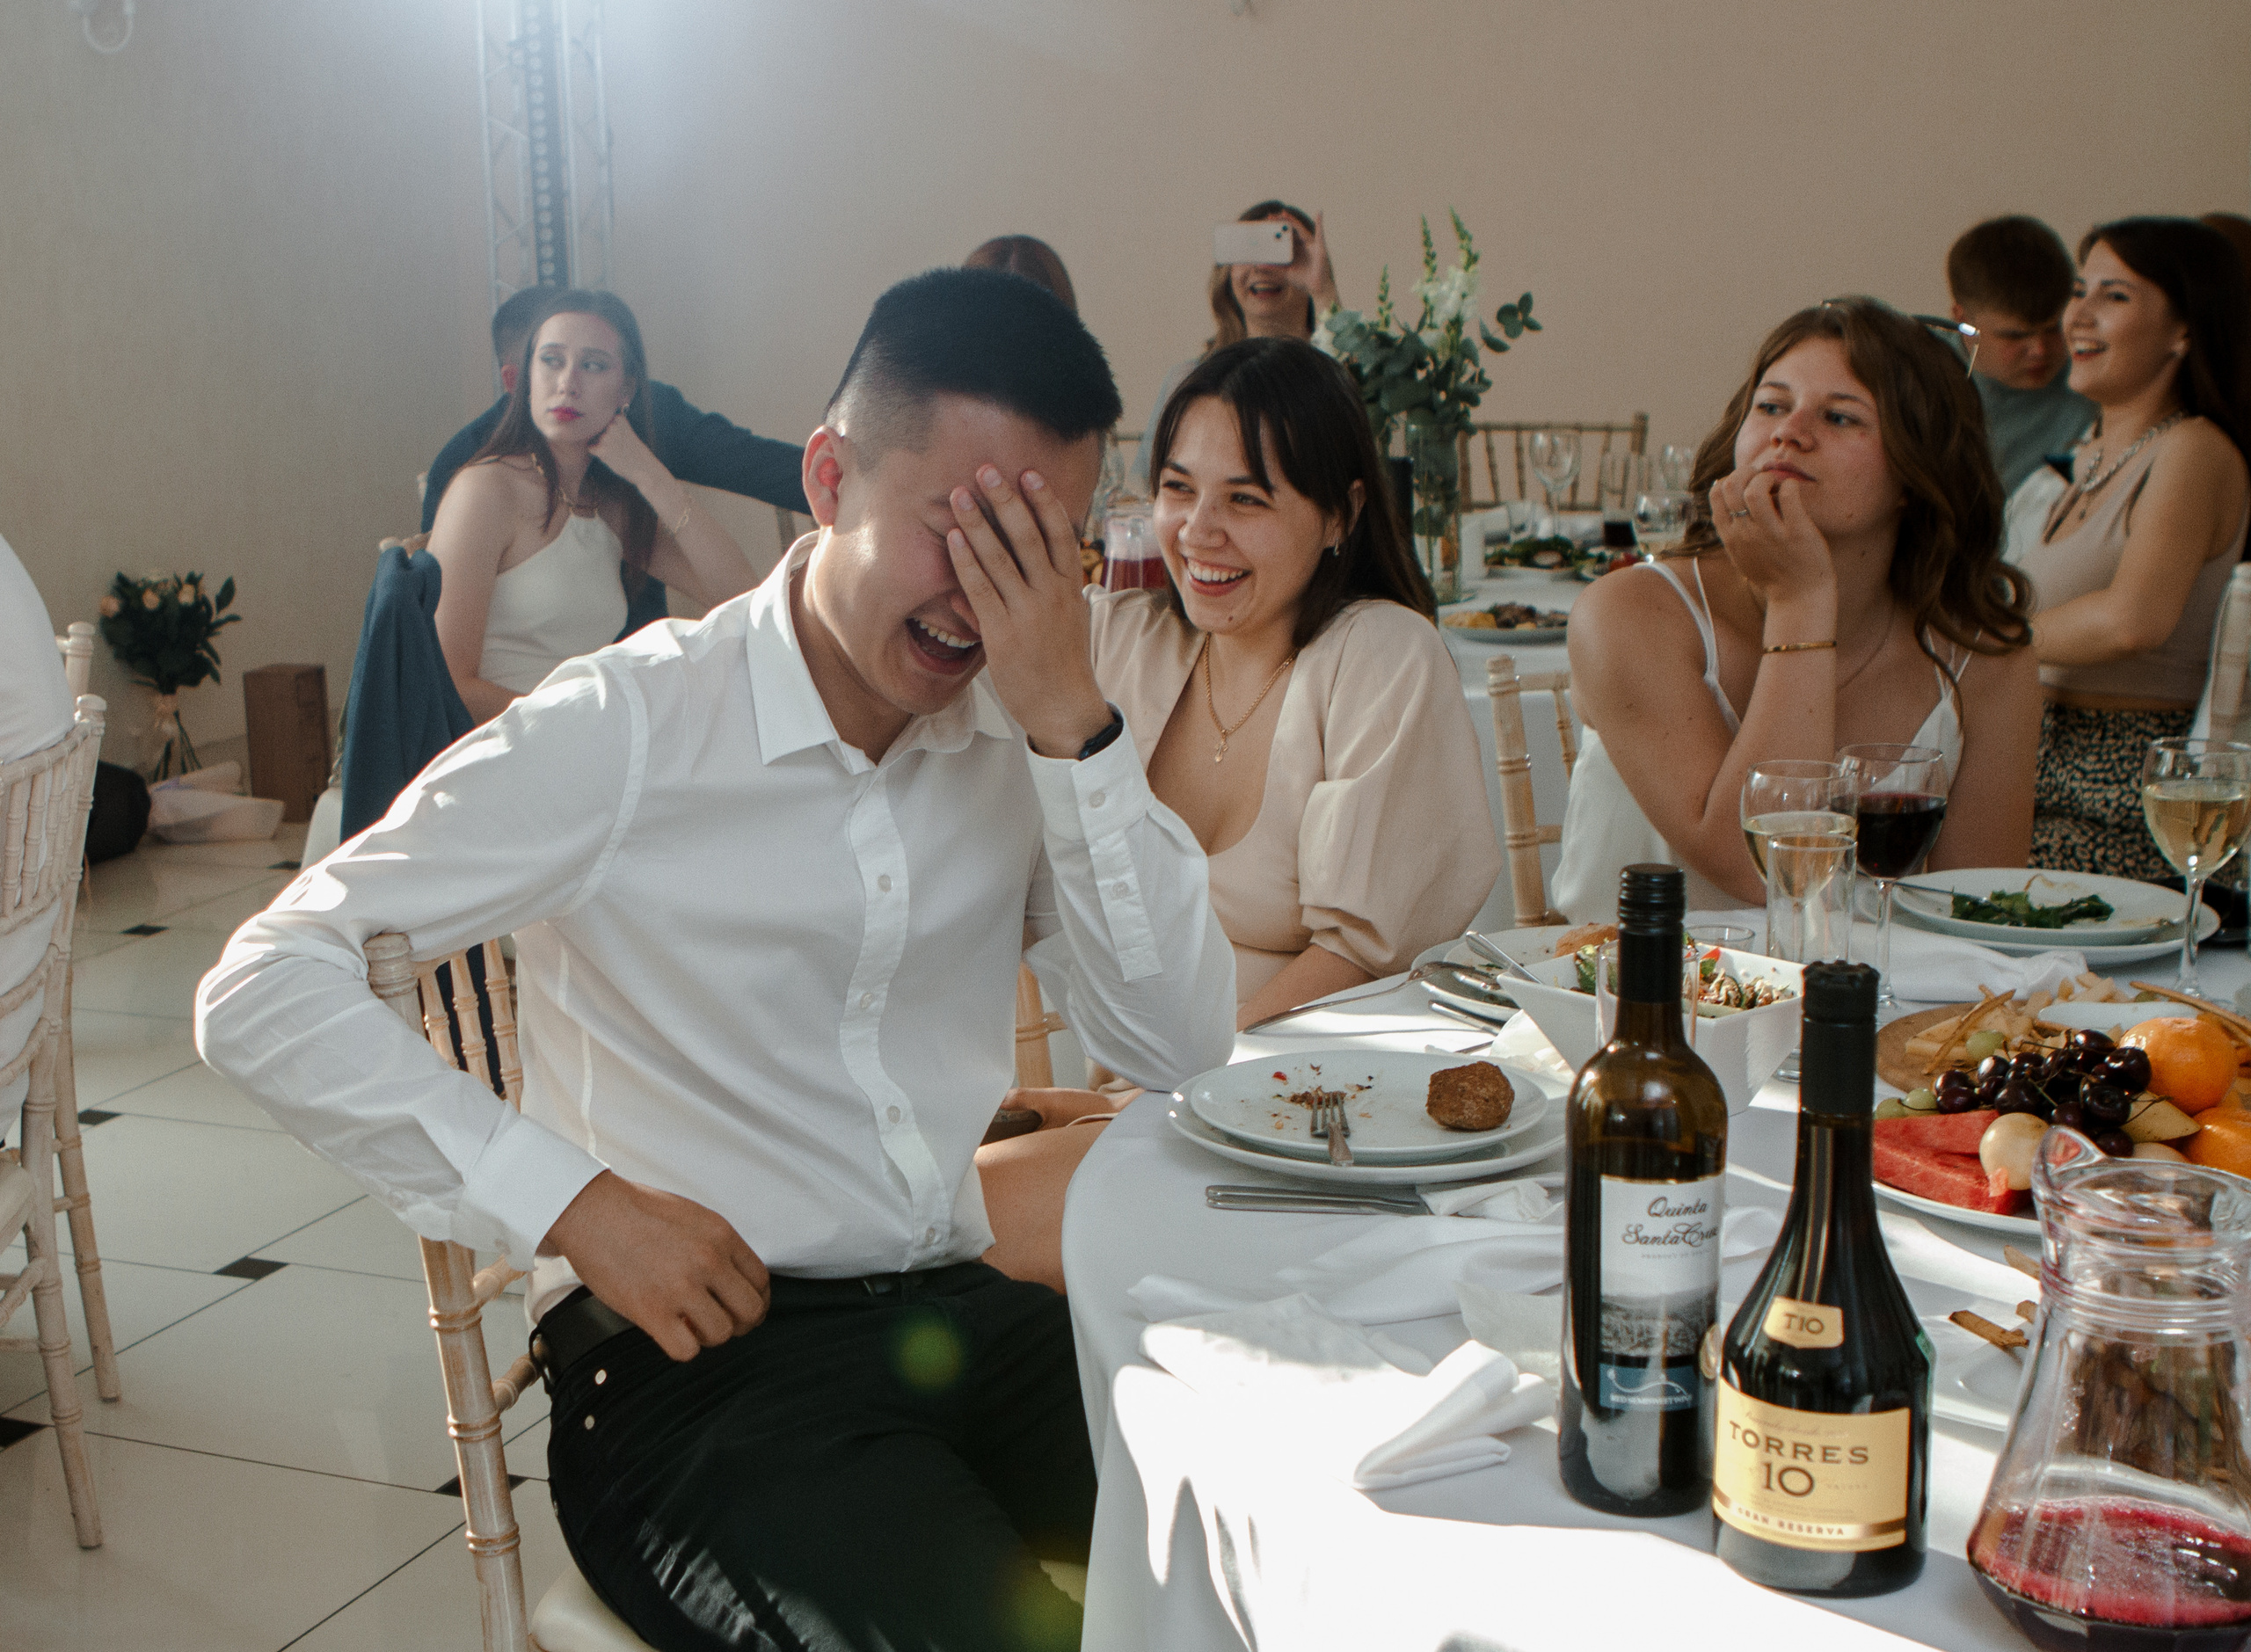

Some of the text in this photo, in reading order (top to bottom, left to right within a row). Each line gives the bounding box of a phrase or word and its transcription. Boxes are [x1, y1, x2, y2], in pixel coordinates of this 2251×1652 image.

[1647, 1197, 1708, 1218] Quinta
[1622, 1224, 1681, 1245] Santa
[1730, 1420, 1869, 1465] TORRES
[1761, 1461, 1814, 1497] 10
[1777, 1519, 1844, 1536] RESERVA
